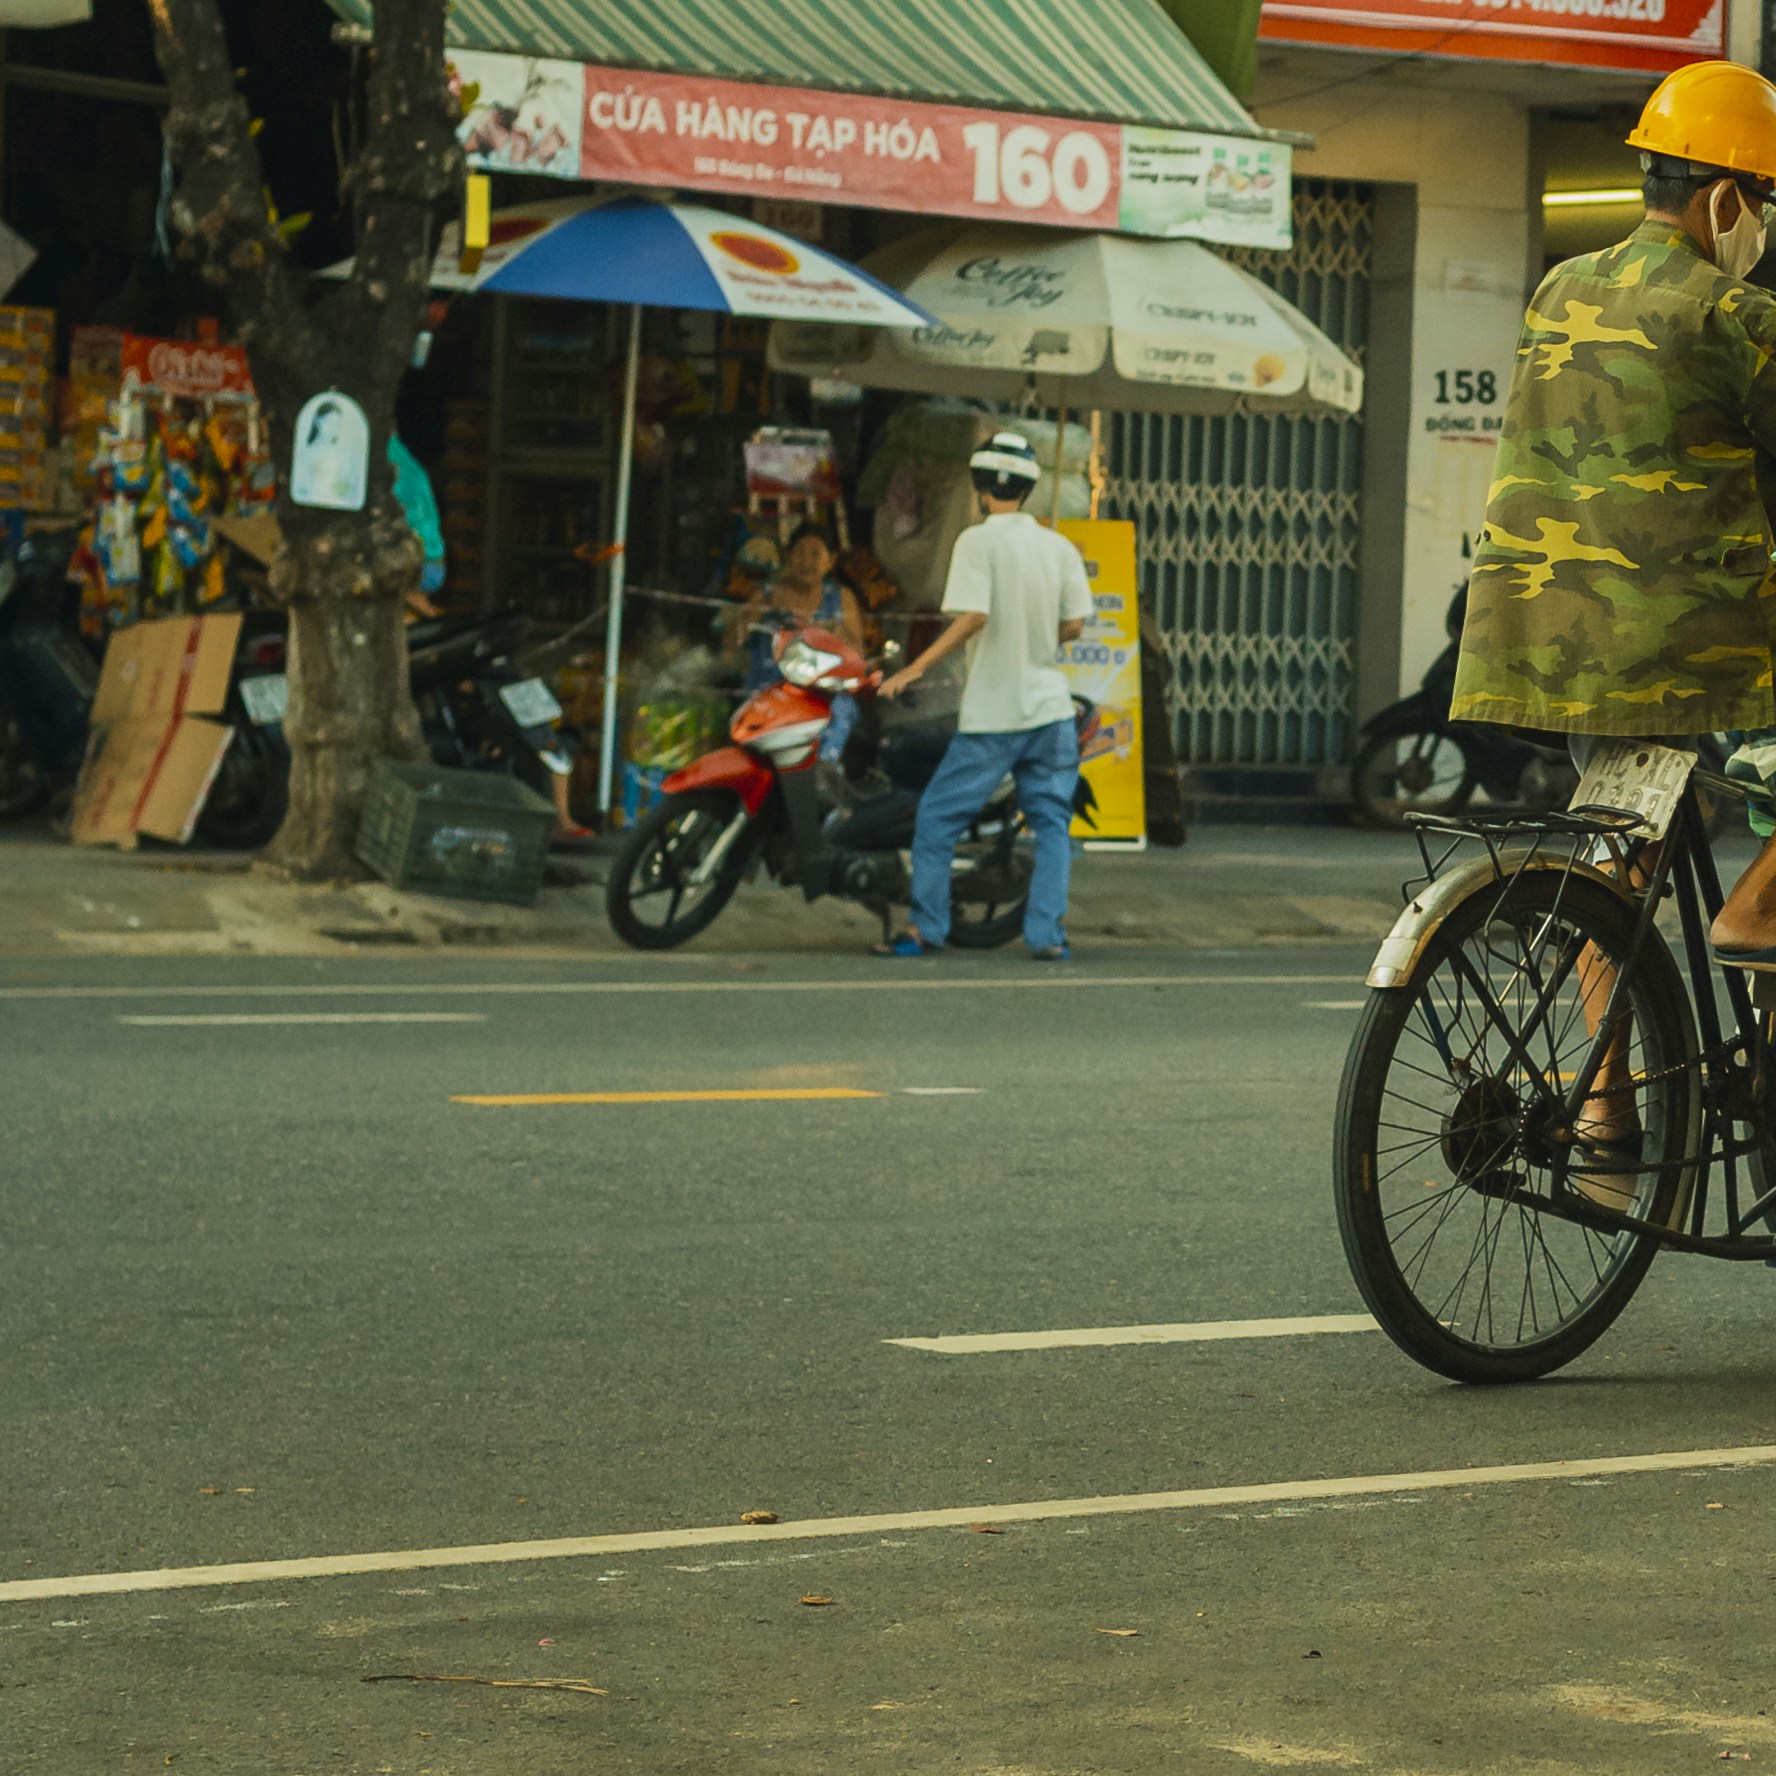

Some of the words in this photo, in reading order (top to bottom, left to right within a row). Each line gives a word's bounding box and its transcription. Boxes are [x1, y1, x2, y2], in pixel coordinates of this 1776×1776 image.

[589, 82, 667, 135] CỬA
[675, 96, 779, 147] HÀNG
[785, 112, 856, 160] TẠP
[863, 117, 940, 164] HÓA
[963, 121, 1112, 216] 160
[1435, 370, 1497, 404] 158
